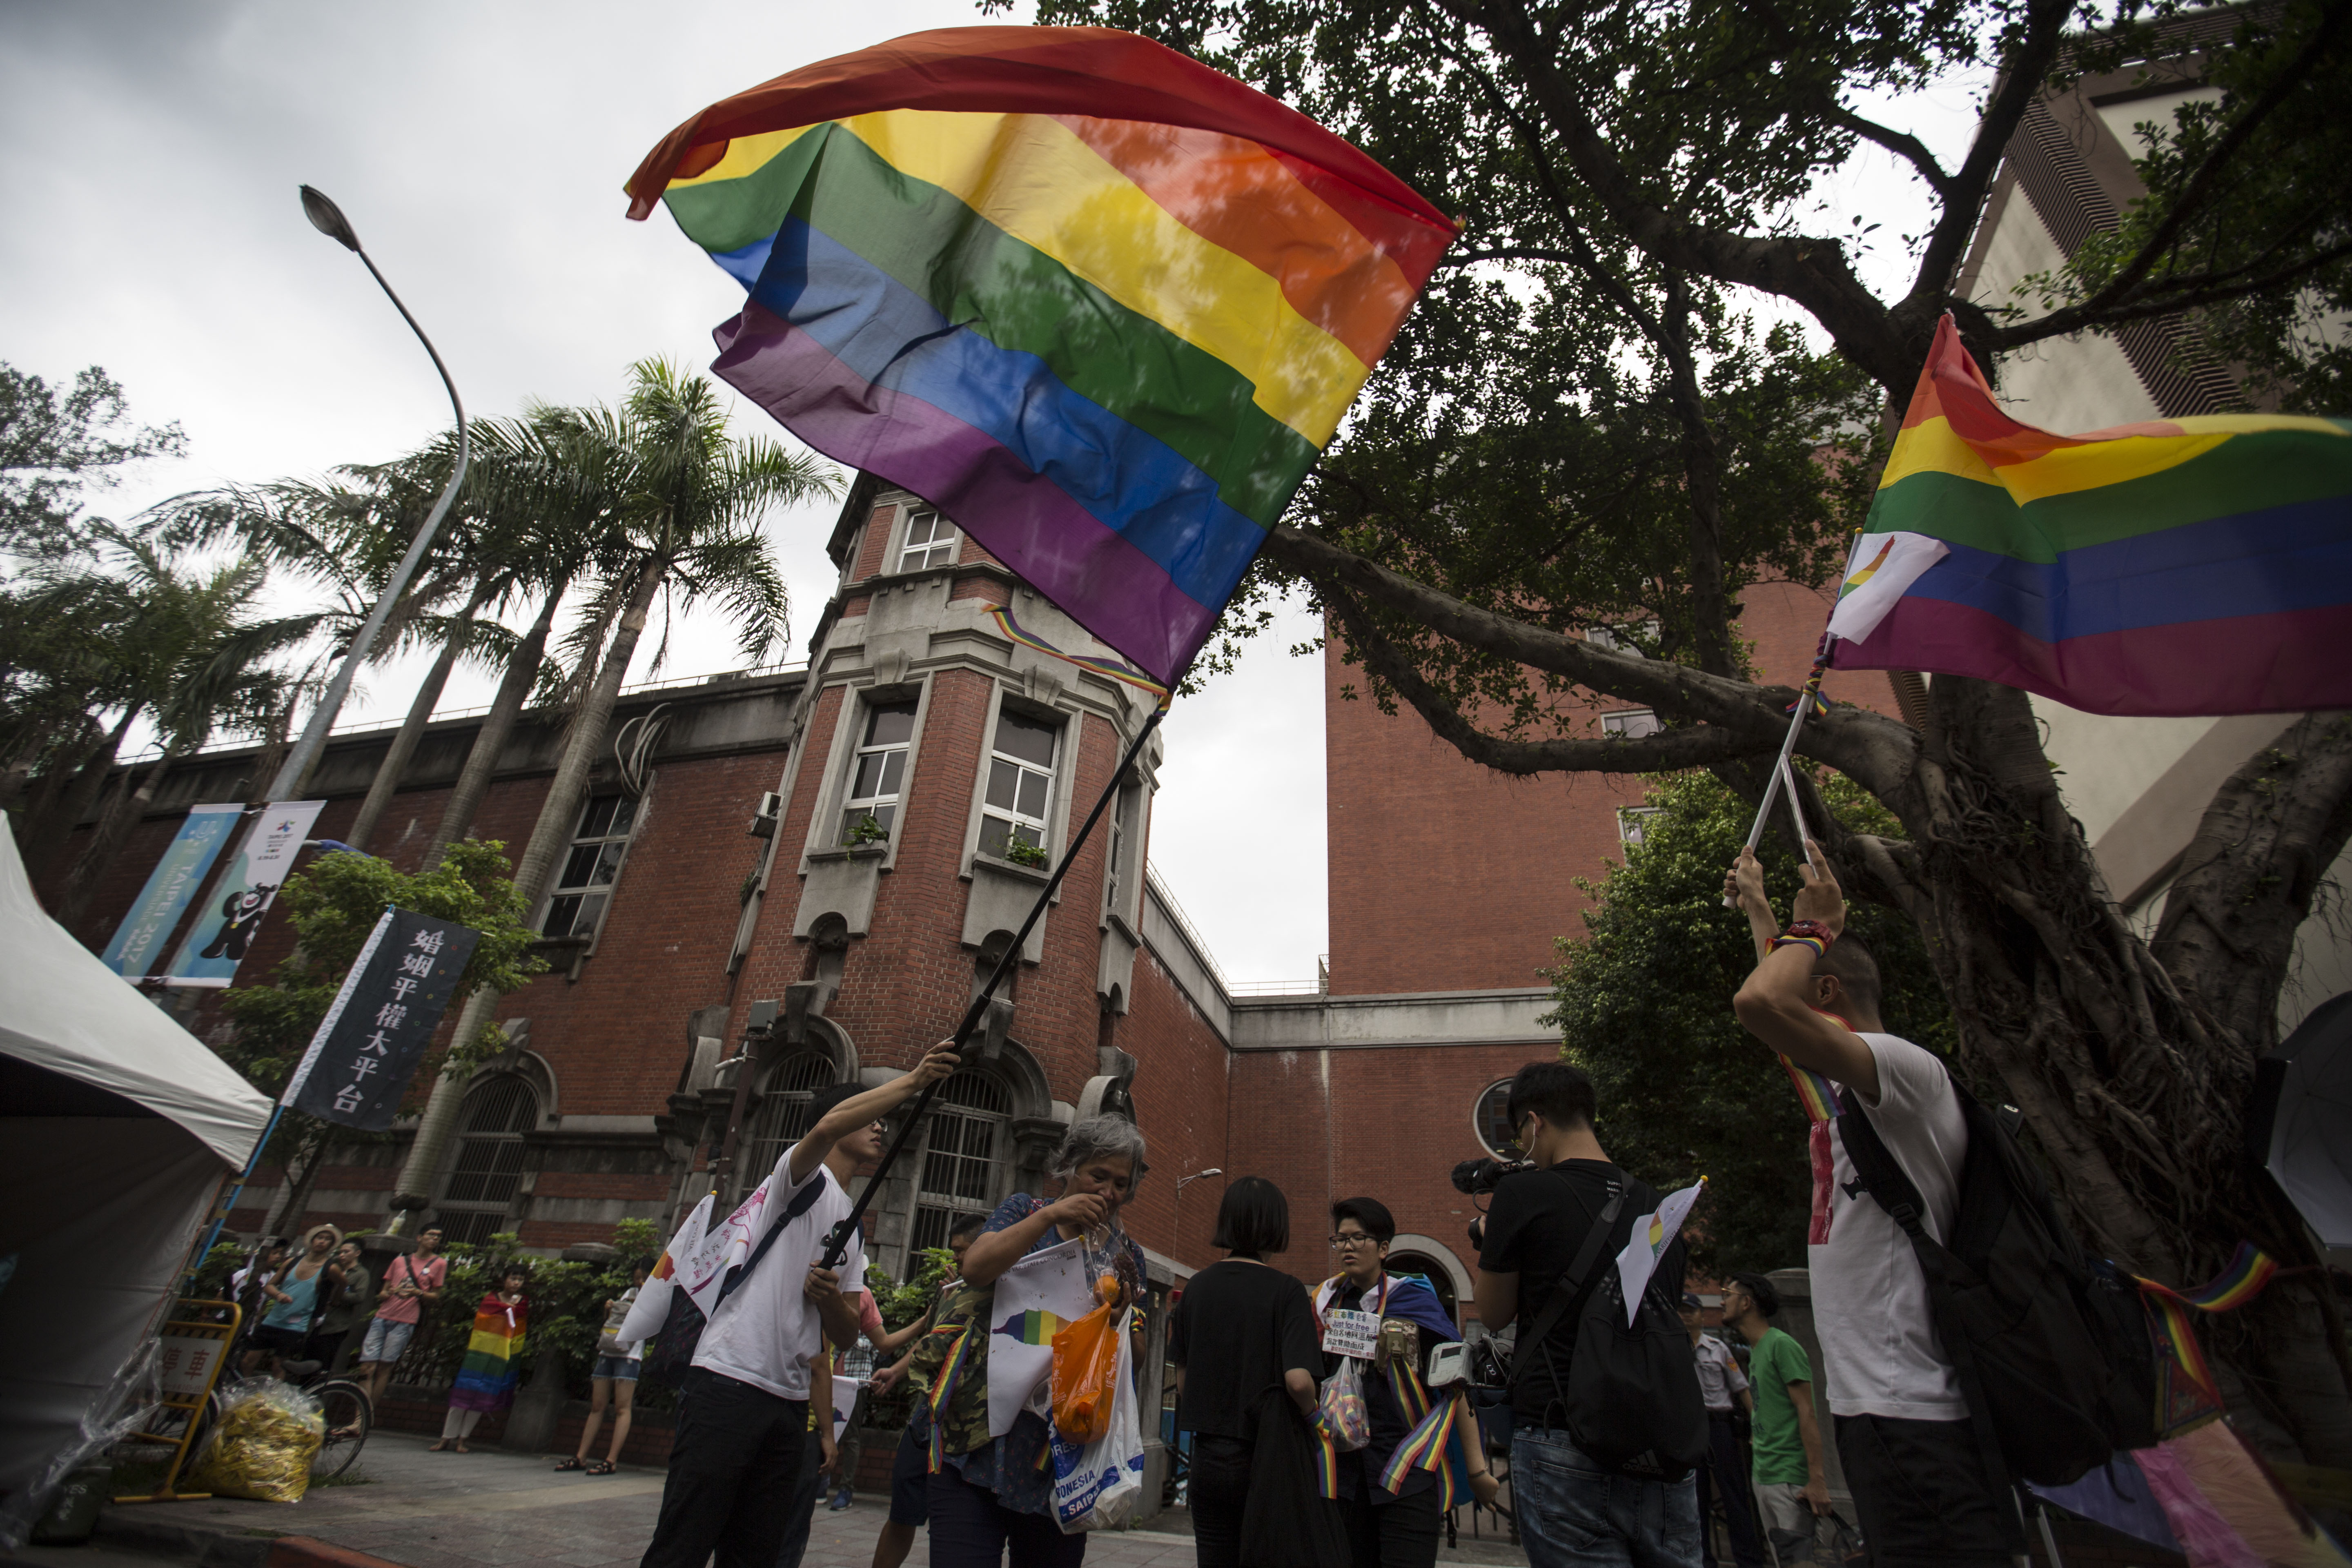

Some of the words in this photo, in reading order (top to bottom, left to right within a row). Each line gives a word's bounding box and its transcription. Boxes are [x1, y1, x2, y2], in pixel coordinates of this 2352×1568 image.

[154, 863, 196, 916] TAIPEI
[128, 923, 159, 963] 2017
[332, 929, 445, 1114] 婚姻平權大平台
[1040, 1250, 1076, 1264] CONCORDIA
[163, 1347, 210, 1380] 停車
[1051, 1442, 1077, 1458] RES
